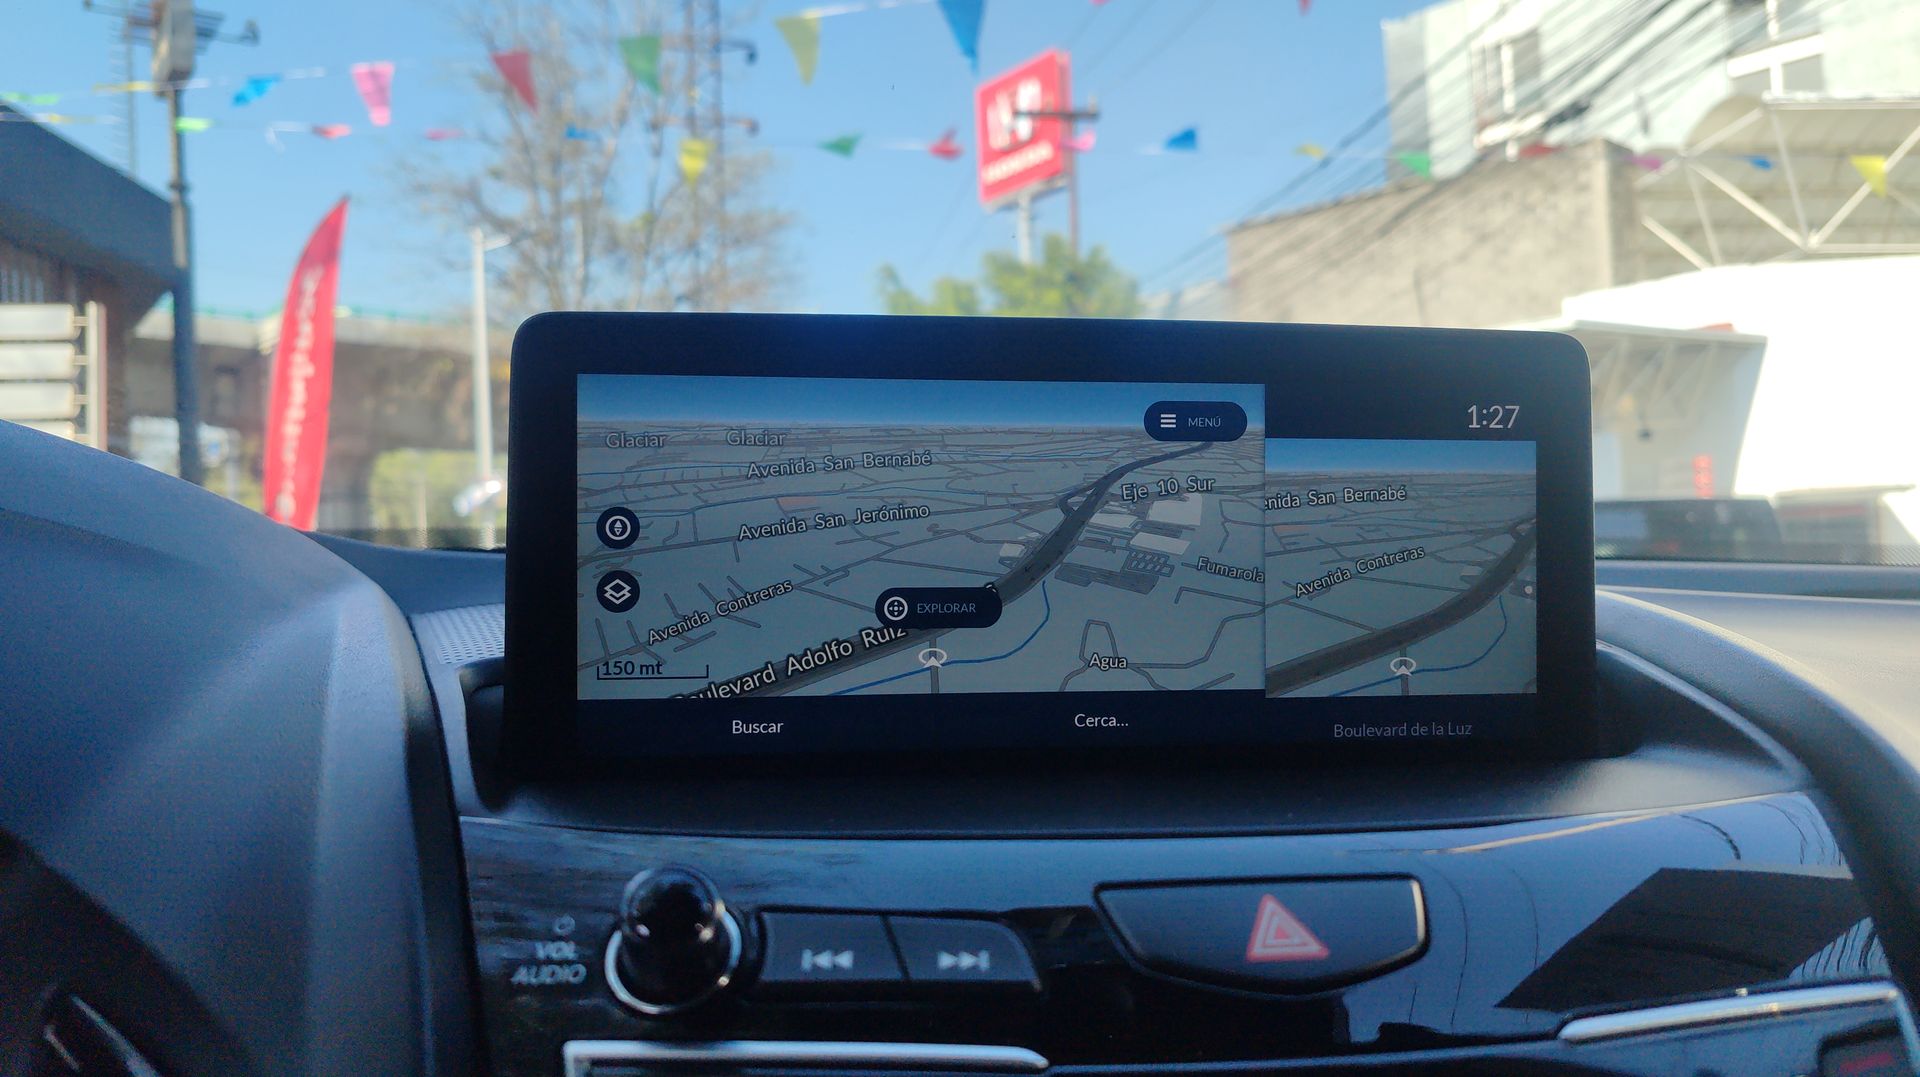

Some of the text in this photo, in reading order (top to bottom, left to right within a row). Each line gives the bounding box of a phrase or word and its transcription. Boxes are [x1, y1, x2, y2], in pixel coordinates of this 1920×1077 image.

[1187, 416, 1222, 429] MENÚ
[1467, 404, 1520, 429] 1:27
[605, 432, 666, 449] Glaciar
[726, 430, 786, 447] Glaciar
[747, 450, 932, 479] Avenida San Bernabé
[1121, 476, 1215, 502] Eje 10 Sur
[1308, 490, 1336, 506] San
[1344, 484, 1407, 503] Bernabé
[738, 504, 931, 541] Avenida San Jerónimo
[1197, 556, 1265, 582] Fumarola
[1295, 546, 1426, 598] Avenida Contreras
[648, 579, 794, 646] Avenida Contreras
[916, 603, 977, 614] EXPLORAR
[786, 639, 854, 675] Adolfo
[1089, 653, 1128, 671] Agua
[602, 661, 663, 676] 150 mt
[732, 719, 784, 734] Buscar
[1074, 713, 1129, 728] Cerca...
[1333, 722, 1472, 738] Boulevard de la Luz
[535, 941, 576, 961] VOL
[511, 963, 587, 984] AUDIO
